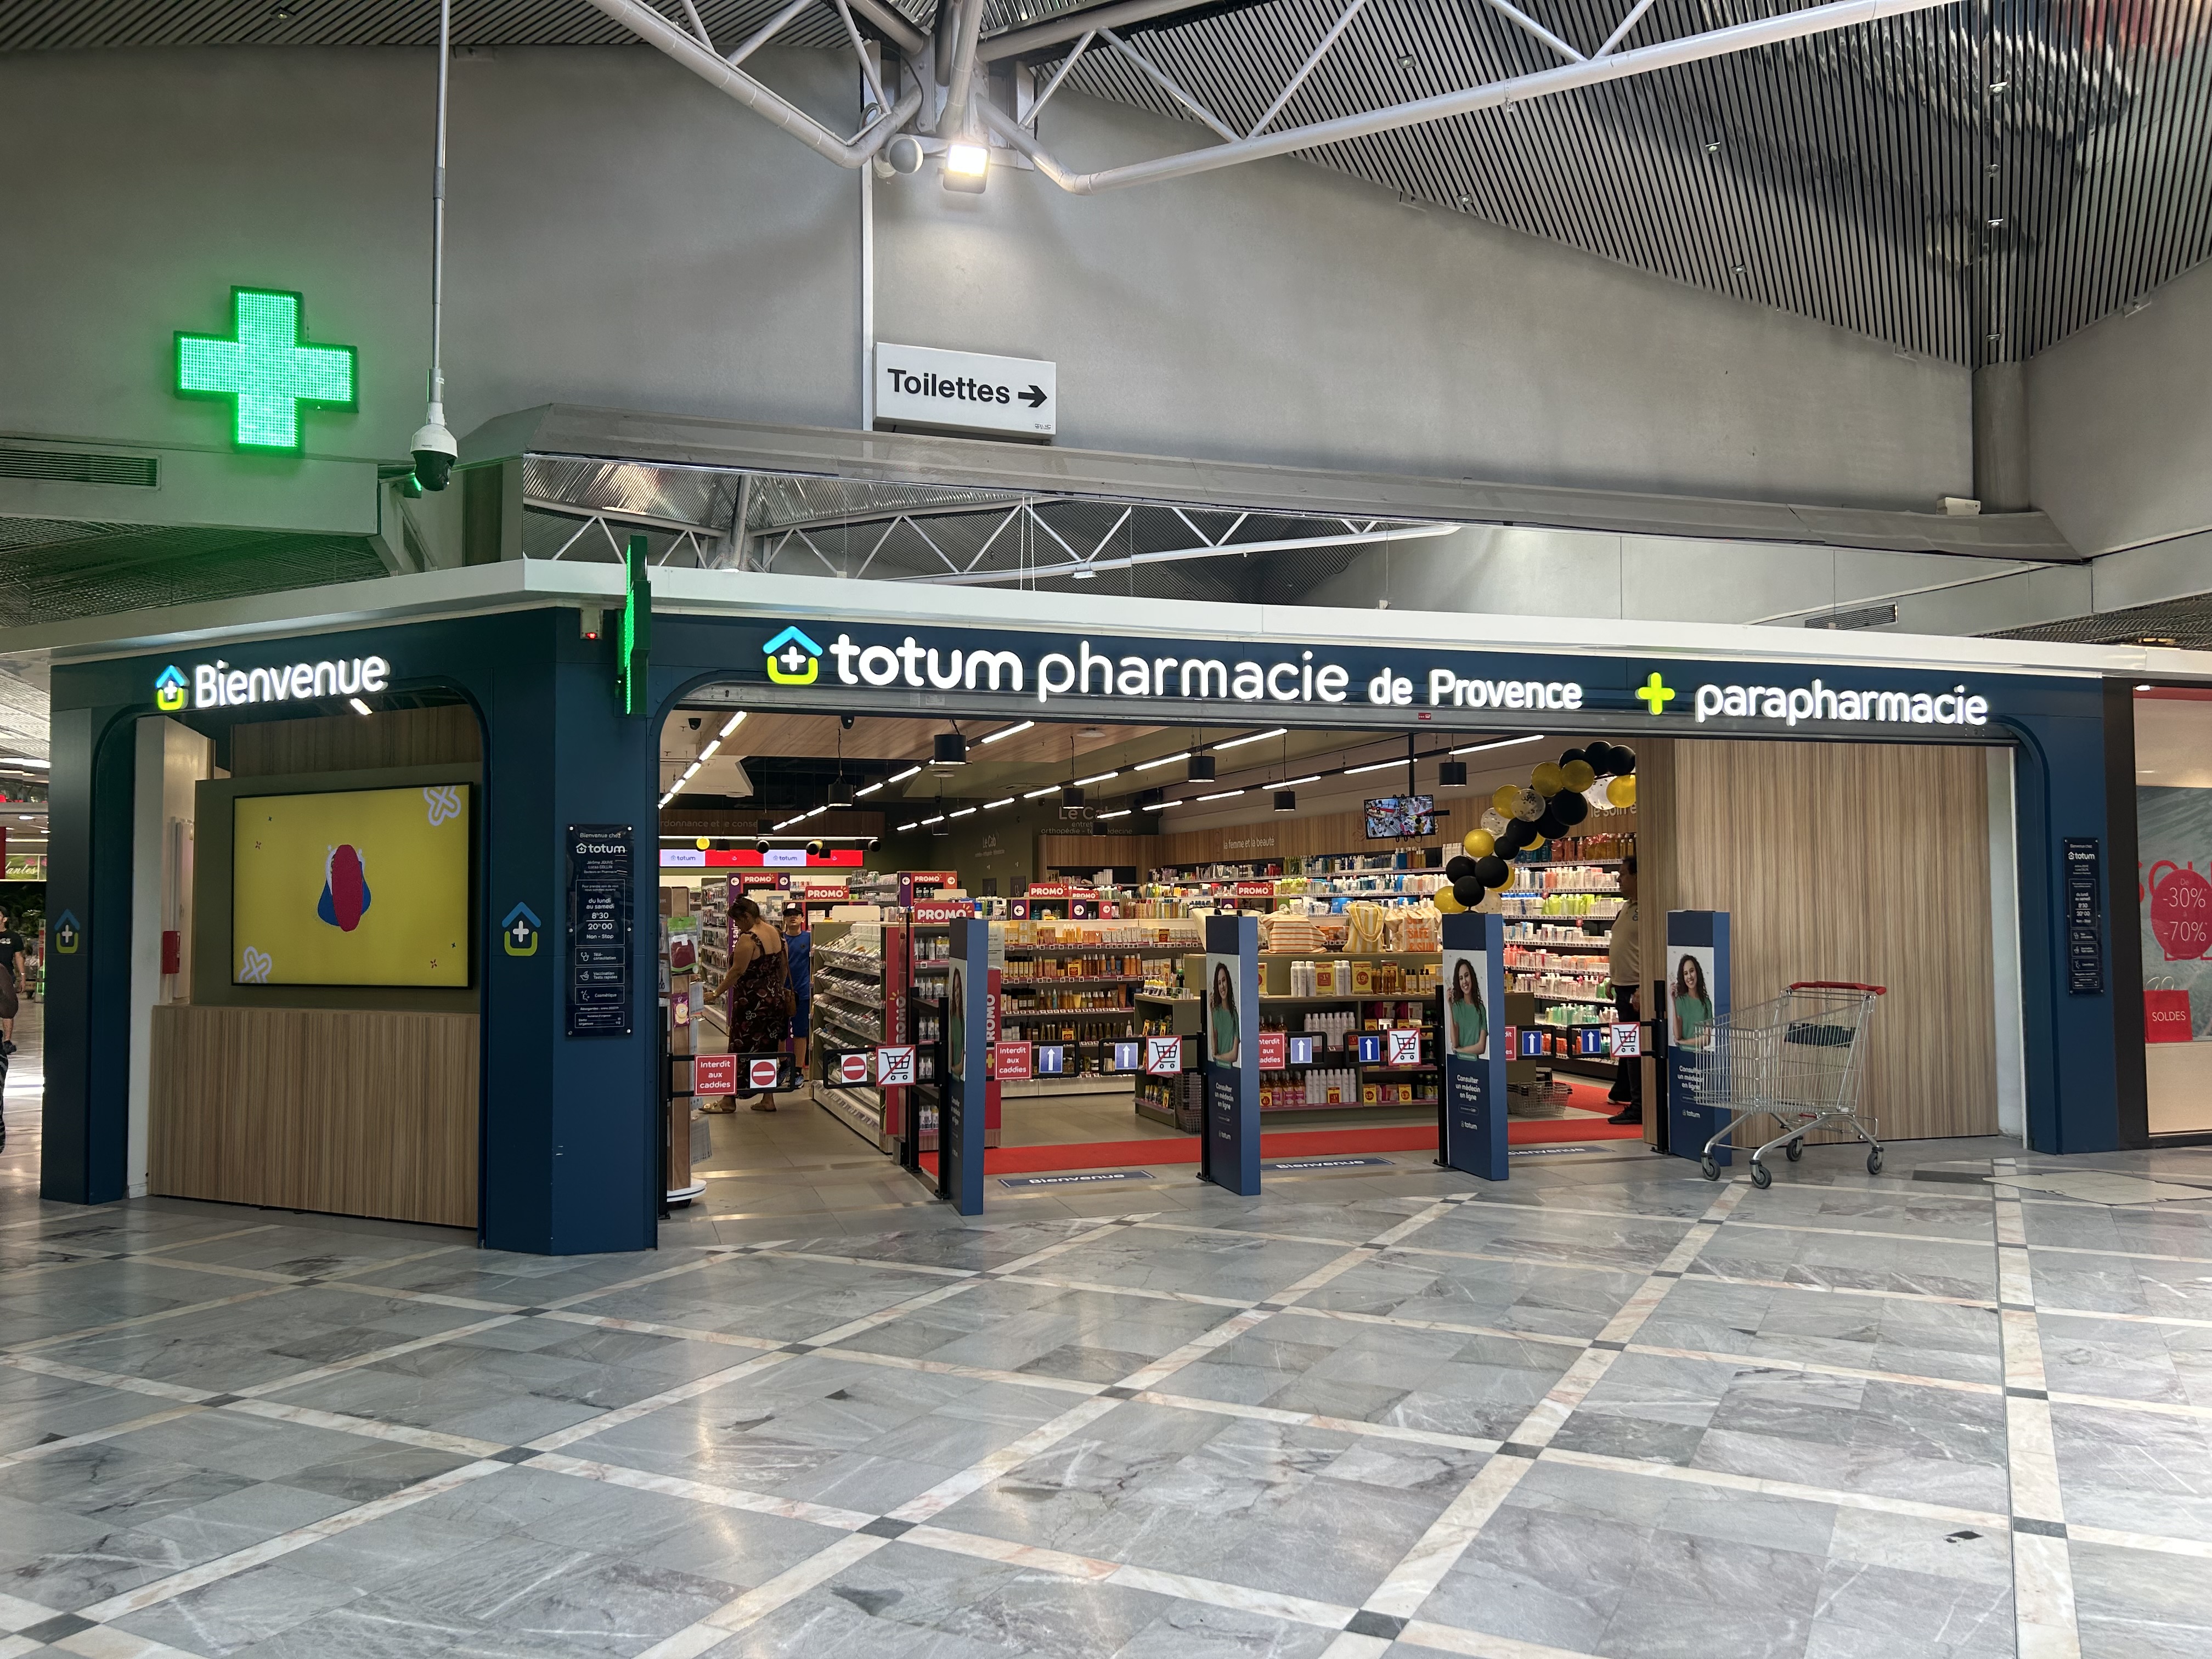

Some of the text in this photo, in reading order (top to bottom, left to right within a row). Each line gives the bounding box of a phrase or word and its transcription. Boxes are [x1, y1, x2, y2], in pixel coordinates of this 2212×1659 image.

[888, 368, 1010, 404] Toilettes
[830, 633, 1583, 710] totum pharmacie de Provence
[195, 656, 390, 709] Bienvenue
[1695, 679, 1988, 727] parapharmacie
[1223, 835, 1275, 850] la femme et la beauté
[588, 844, 626, 854] totum
[2074, 852, 2096, 860] totum
[5, 861, 39, 874] lantes
[808, 889, 844, 898] PROMO
[1031, 887, 1064, 895] PROMO
[917, 909, 967, 920] PROMO
[1407, 928, 1429, 939] SAFE
[896, 996, 906, 1044] ROMO
[986, 994, 996, 1041] ROMO
[2152, 1011, 2186, 1022] SOLDES
[701, 1060, 731, 1068] Interdit
[699, 1081, 731, 1089] caddies
[1276, 1160, 1365, 1169] Bienvenue
[1029, 1174, 1125, 1184] Bienvenue
